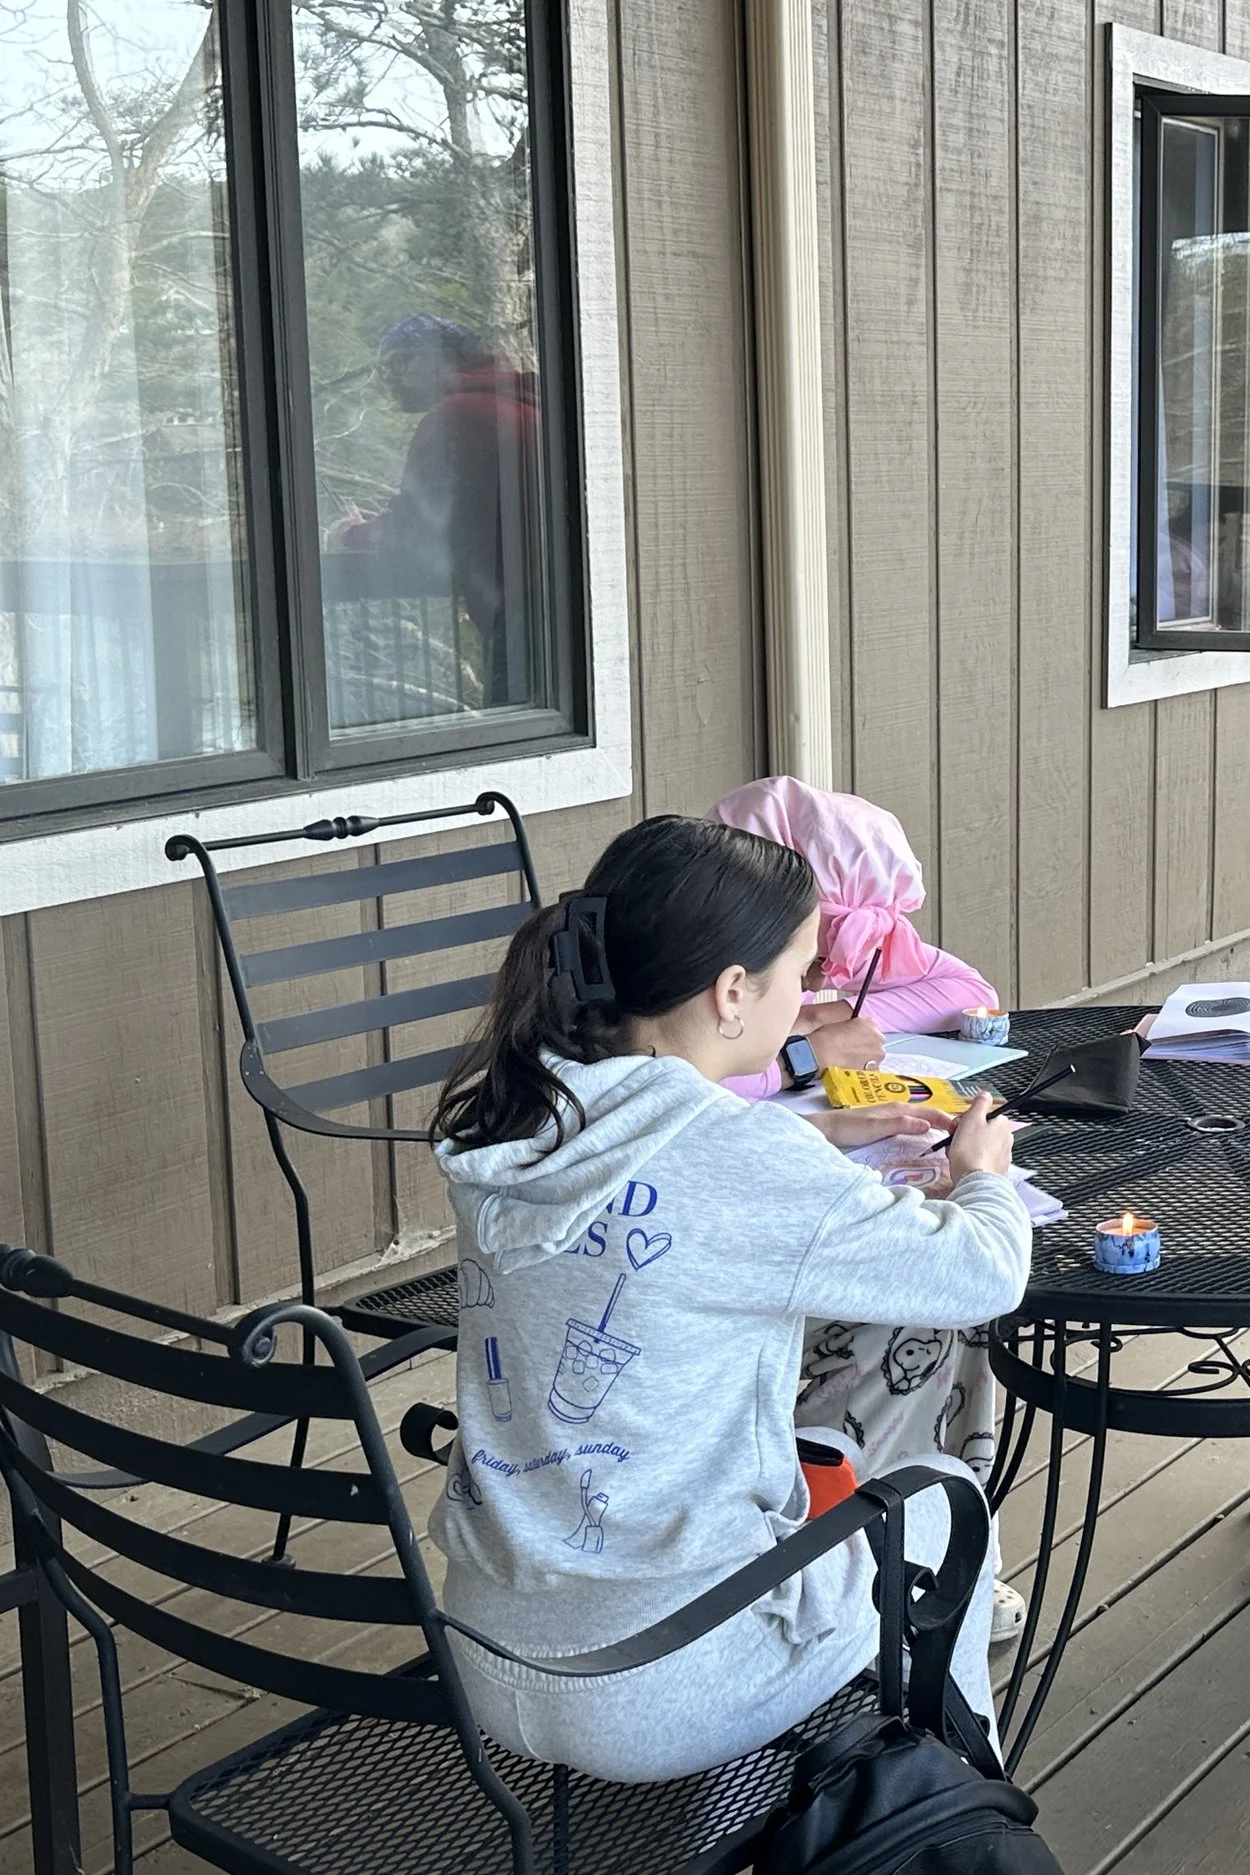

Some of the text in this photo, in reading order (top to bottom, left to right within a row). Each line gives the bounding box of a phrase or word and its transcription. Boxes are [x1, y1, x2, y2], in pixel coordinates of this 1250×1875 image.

[471, 1441, 630, 1477] friday, saturday, sunday
